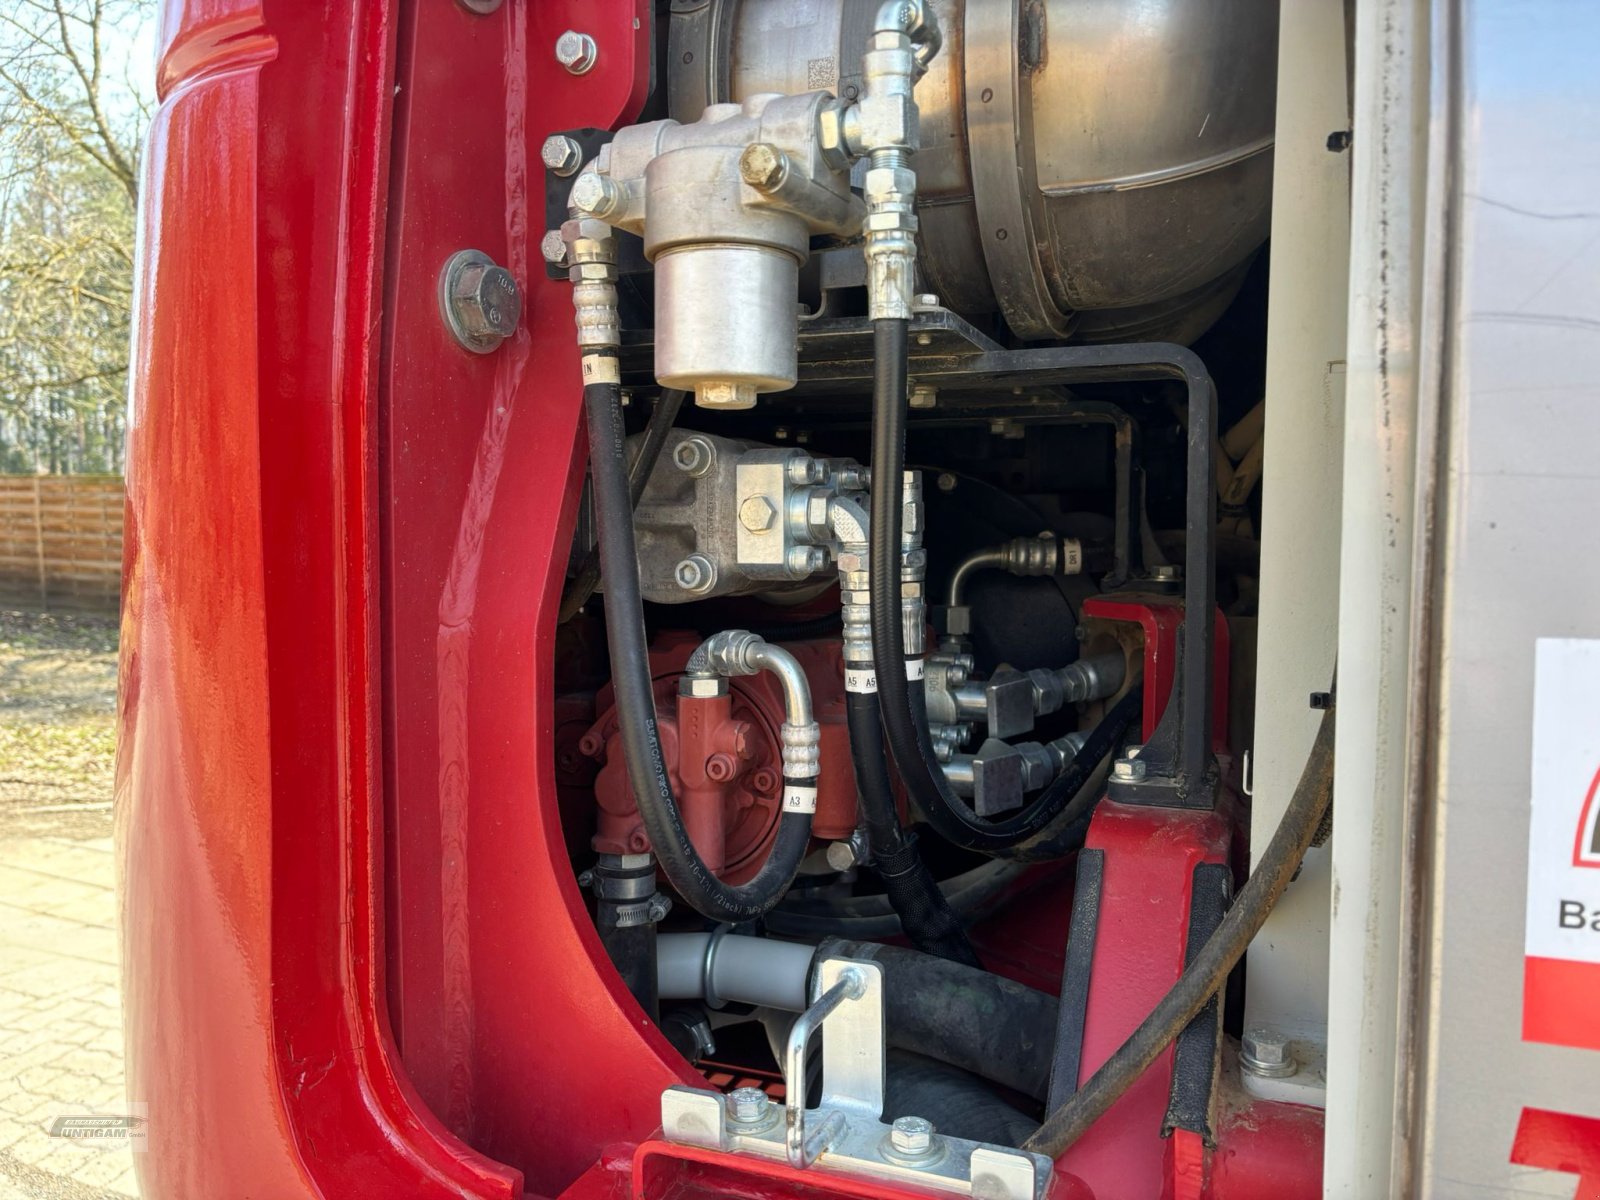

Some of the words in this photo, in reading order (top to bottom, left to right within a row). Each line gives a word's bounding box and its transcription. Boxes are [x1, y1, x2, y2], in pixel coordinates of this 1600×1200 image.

[583, 363, 593, 375] IN
[1069, 550, 1077, 565] DR1
[847, 676, 858, 687] A5
[865, 677, 876, 688] A5
[789, 795, 801, 807] A3
